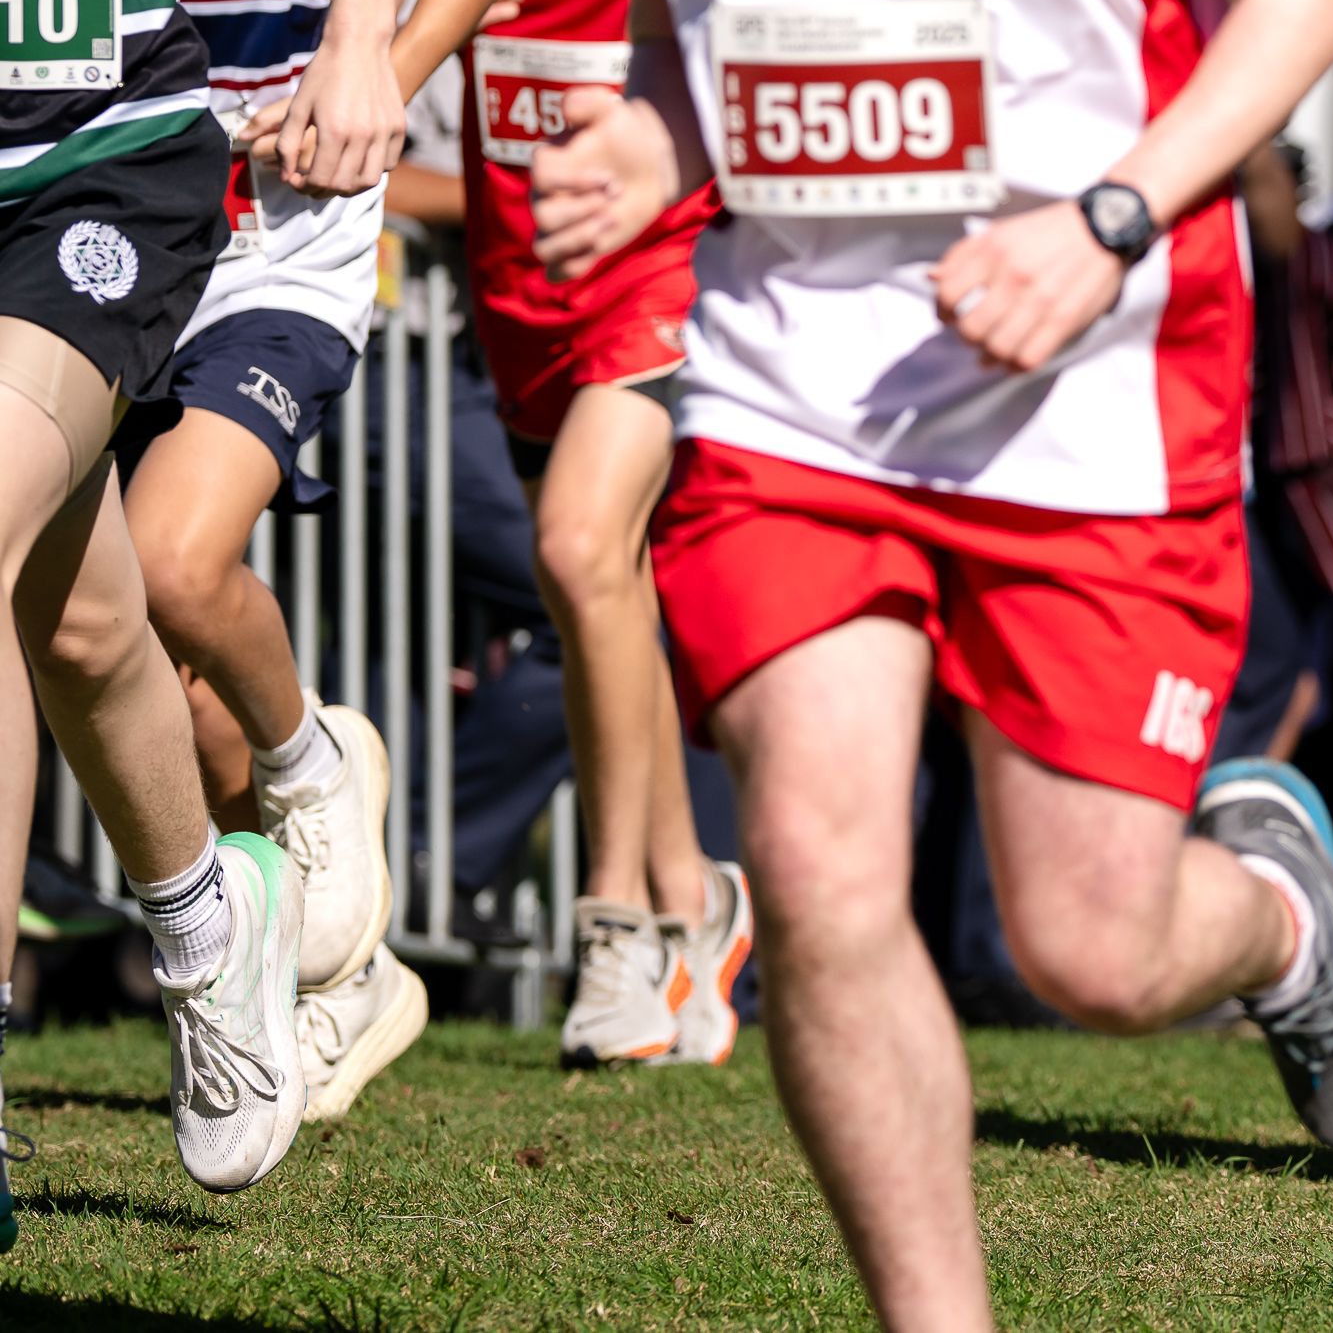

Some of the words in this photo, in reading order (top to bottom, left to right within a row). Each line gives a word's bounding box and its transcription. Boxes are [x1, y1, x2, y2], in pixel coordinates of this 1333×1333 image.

[508, 86, 566, 135] 45
[754, 77, 954, 164] 5509
[247, 365, 301, 429] TSS
